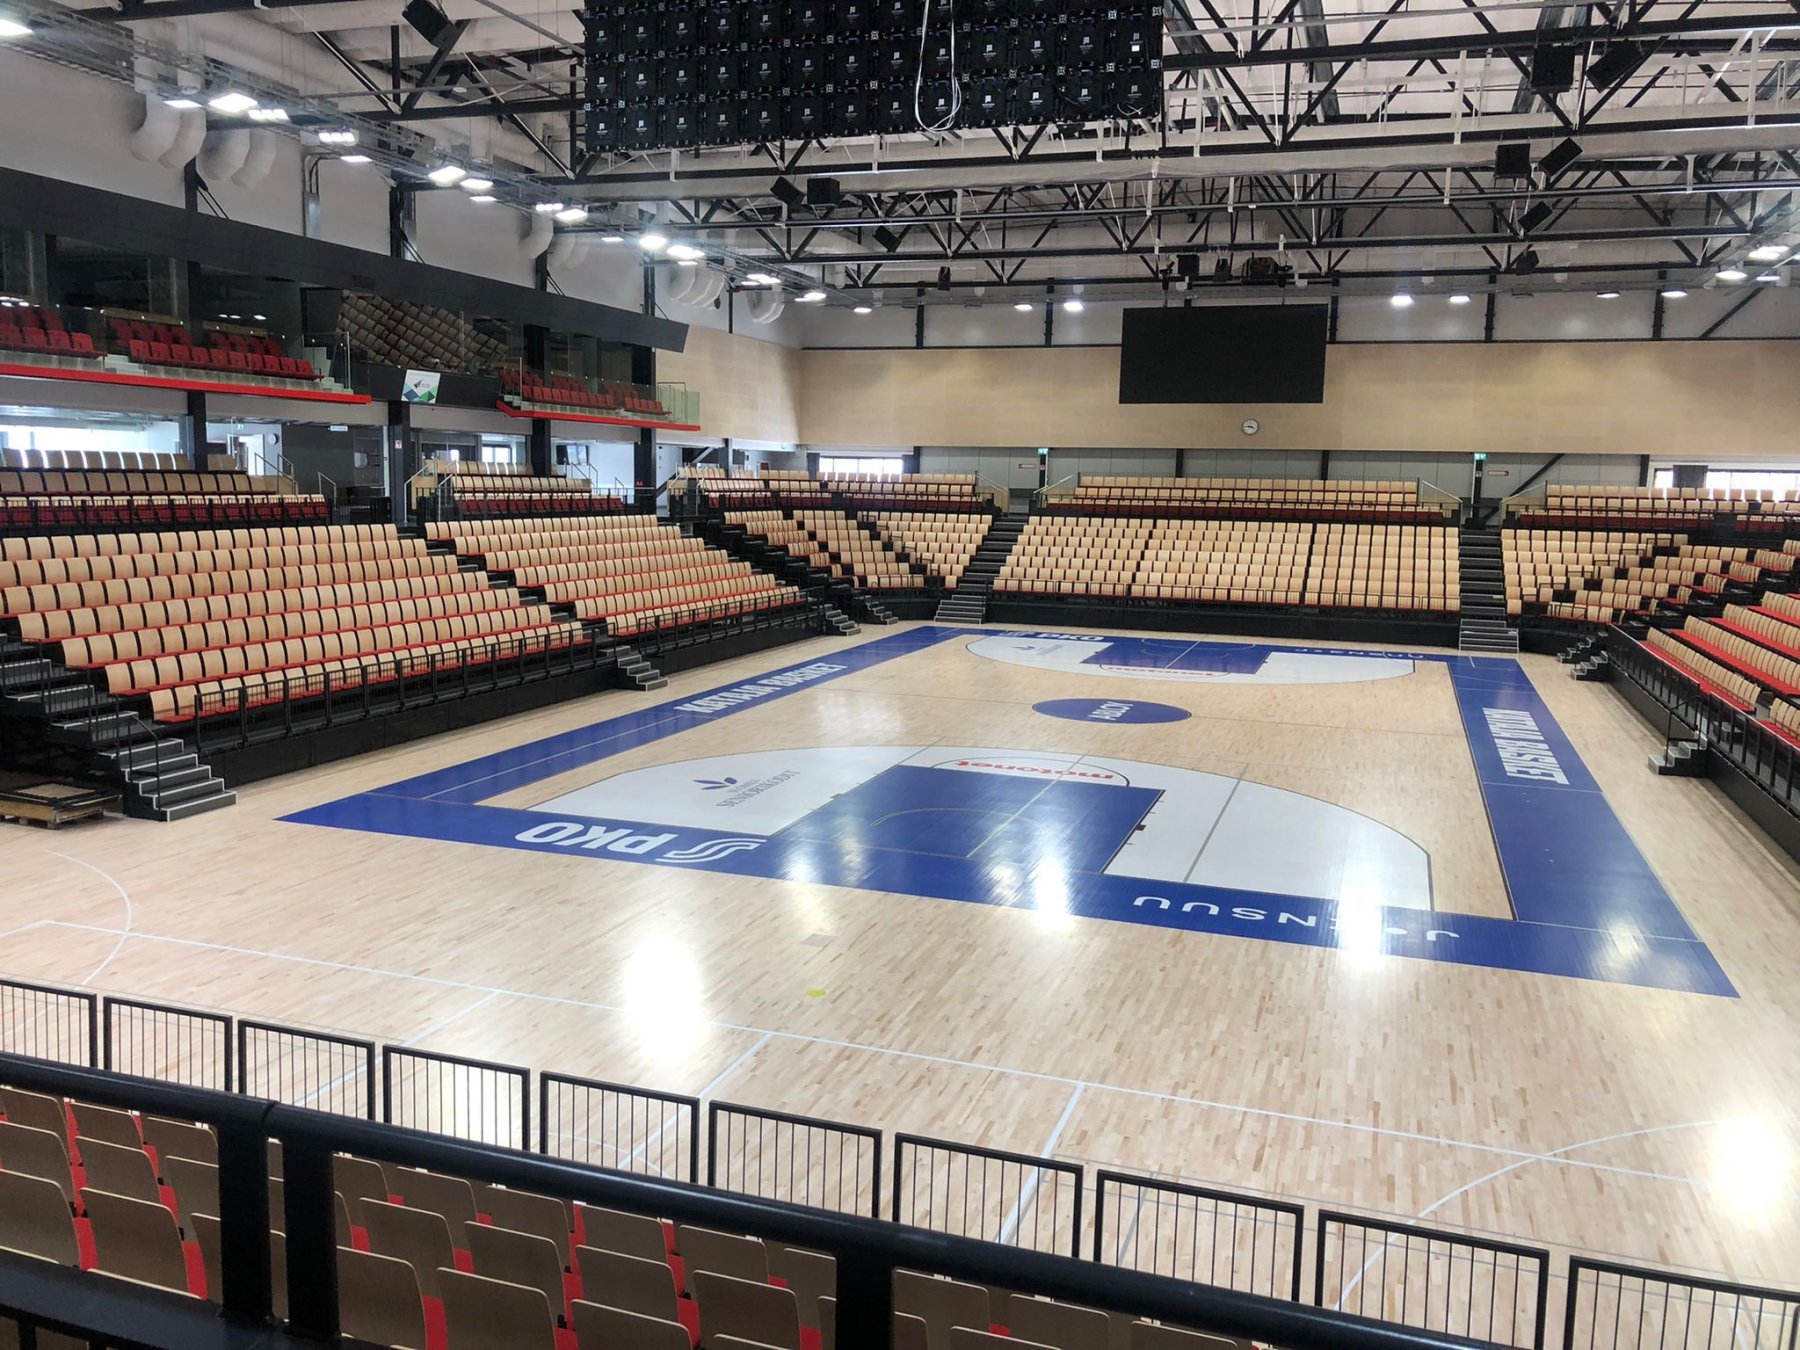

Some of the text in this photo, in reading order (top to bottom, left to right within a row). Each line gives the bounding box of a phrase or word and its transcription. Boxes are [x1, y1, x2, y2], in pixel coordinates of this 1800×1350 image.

[1036, 633, 1105, 641] PKO
[674, 662, 848, 713] KATAJA BASKET
[1482, 707, 1570, 785] KATAJA BASKET
[954, 760, 1114, 779] motonet
[515, 821, 678, 855] PKO
[1133, 896, 1460, 942] JNSUU
